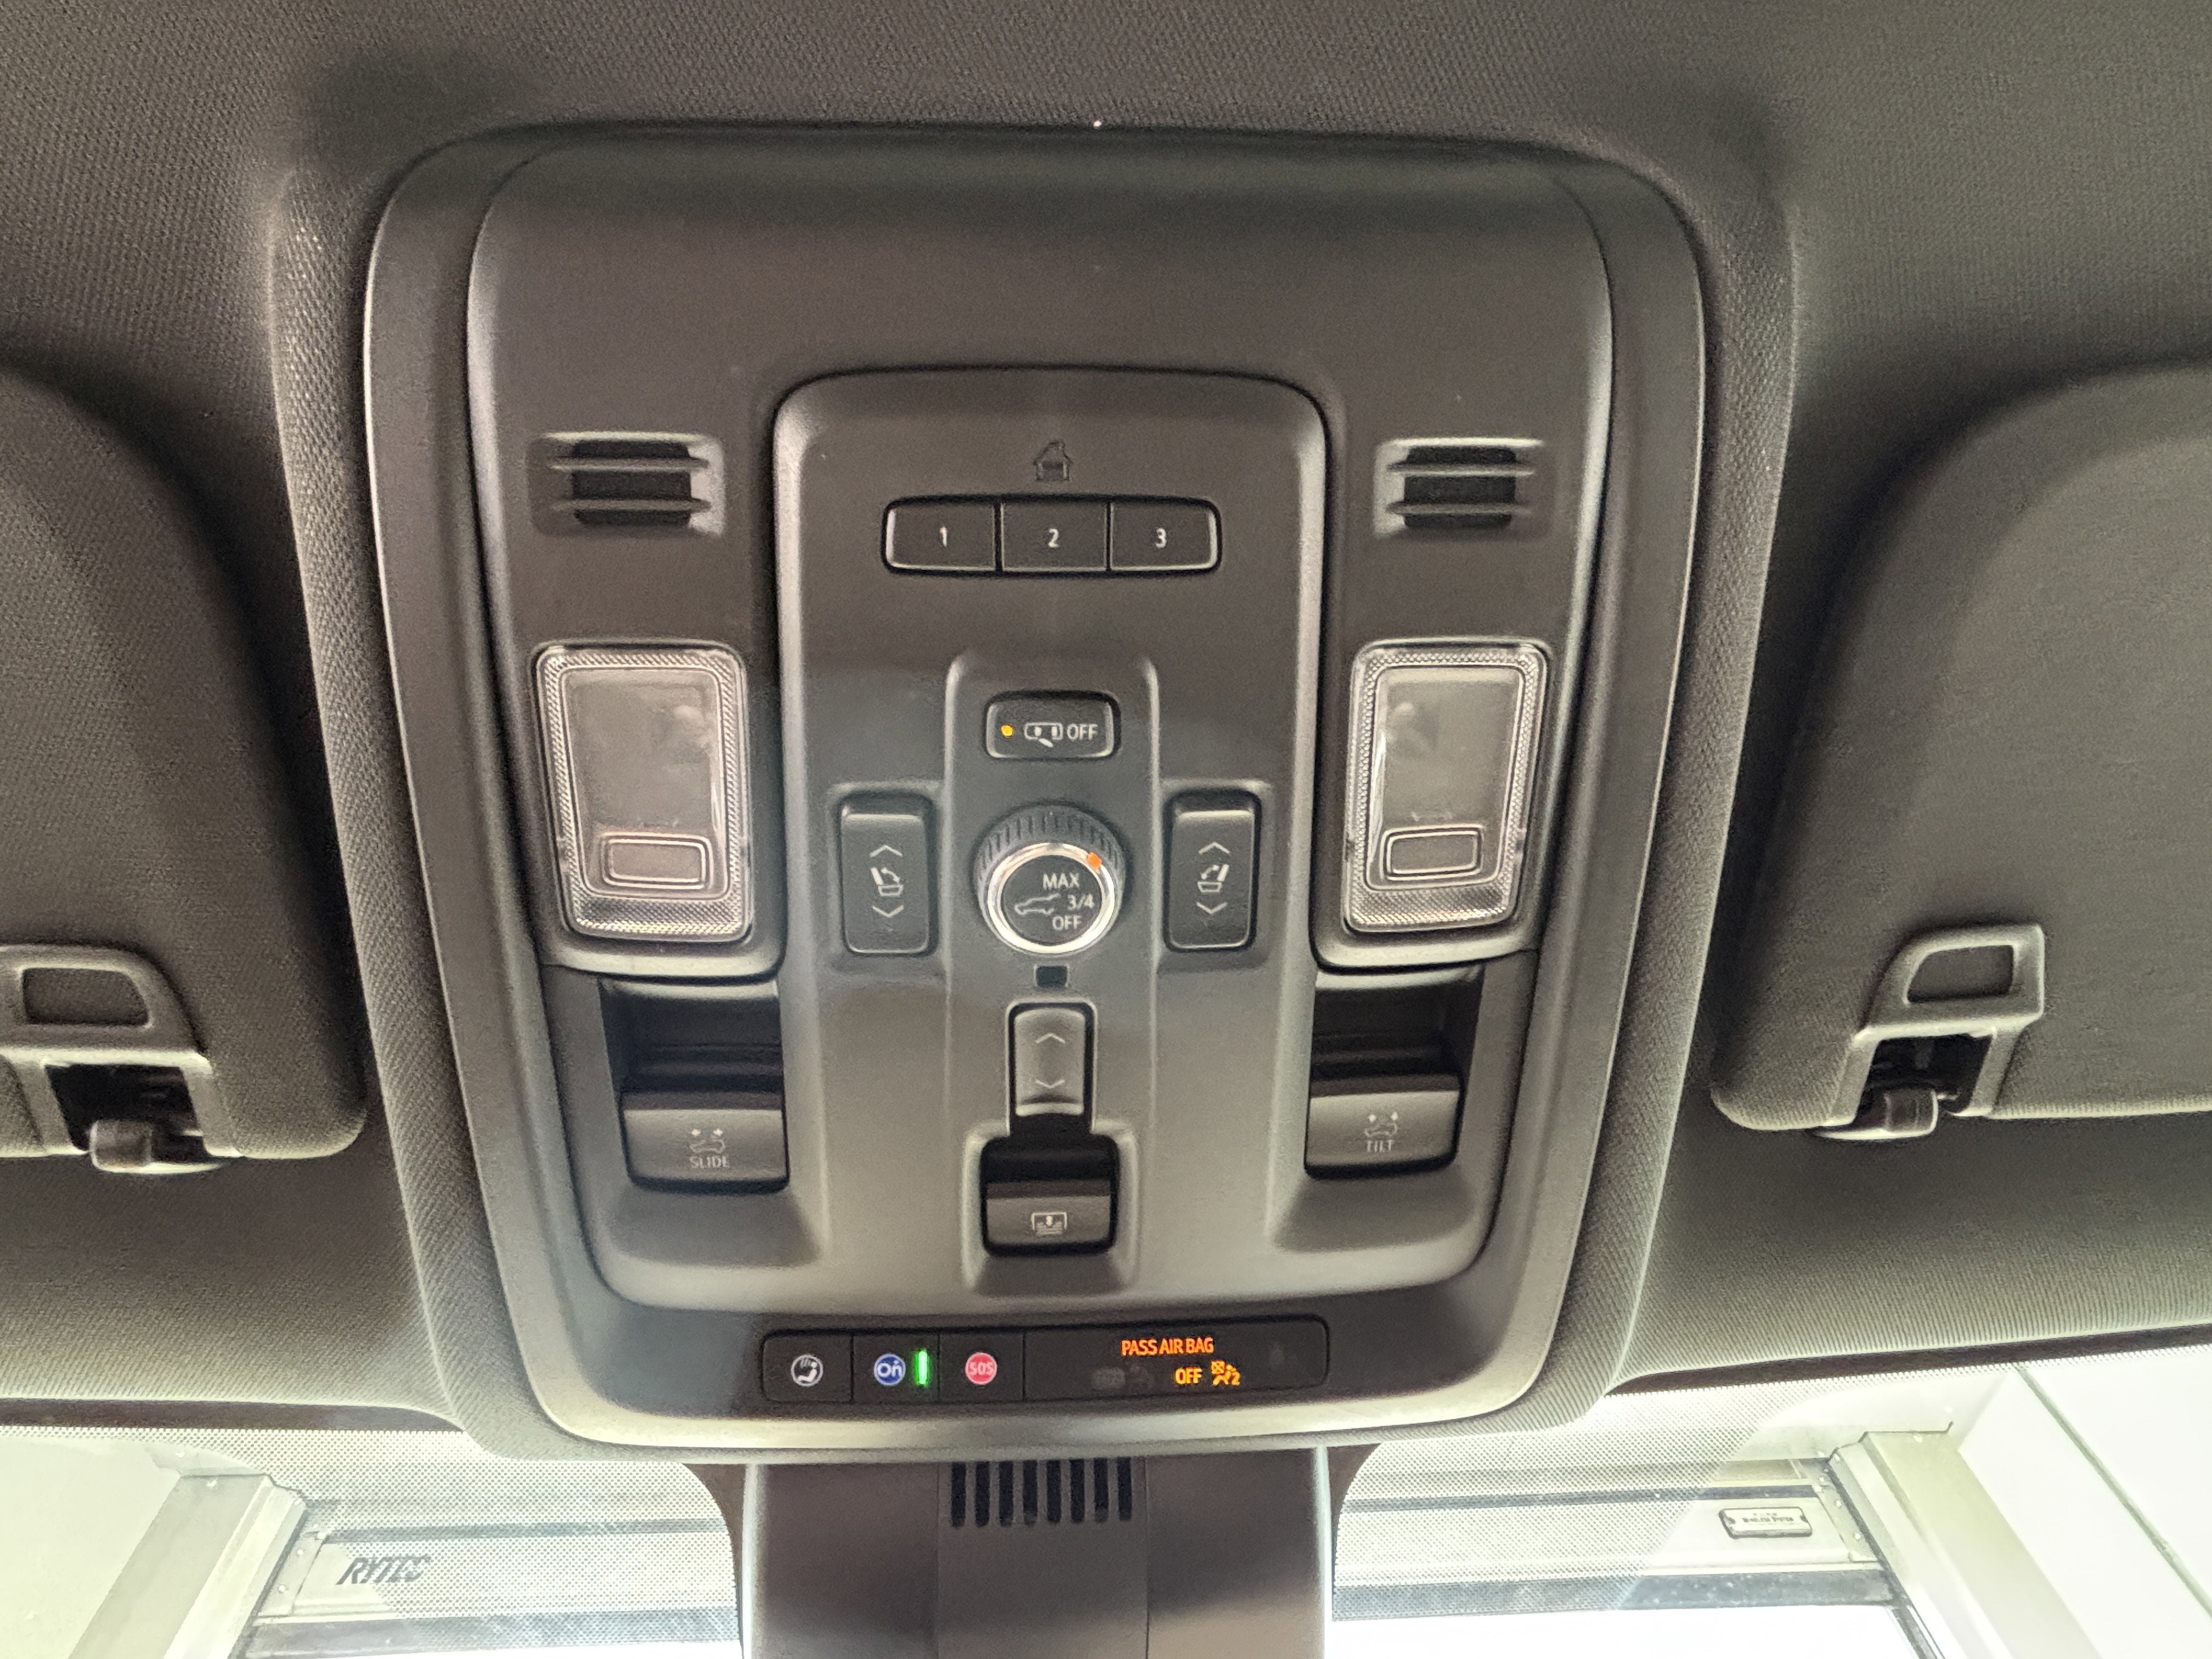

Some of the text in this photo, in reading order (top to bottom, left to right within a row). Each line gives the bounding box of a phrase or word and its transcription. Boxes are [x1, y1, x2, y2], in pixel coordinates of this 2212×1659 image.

[940, 526, 948, 547] 1
[1047, 528, 1060, 548] 2
[1155, 528, 1168, 549] 3
[1066, 724, 1098, 740] OFF
[1043, 872, 1080, 890] MAX
[1068, 893, 1096, 911] 3/4
[1052, 915, 1082, 930] OFF
[1365, 1139, 1395, 1152] TILT
[689, 1156, 730, 1169] SLIDE
[1121, 1336, 1214, 1356] PASS AIR BAG
[968, 1361, 994, 1376] SOS
[1174, 1367, 1203, 1385] OFF
